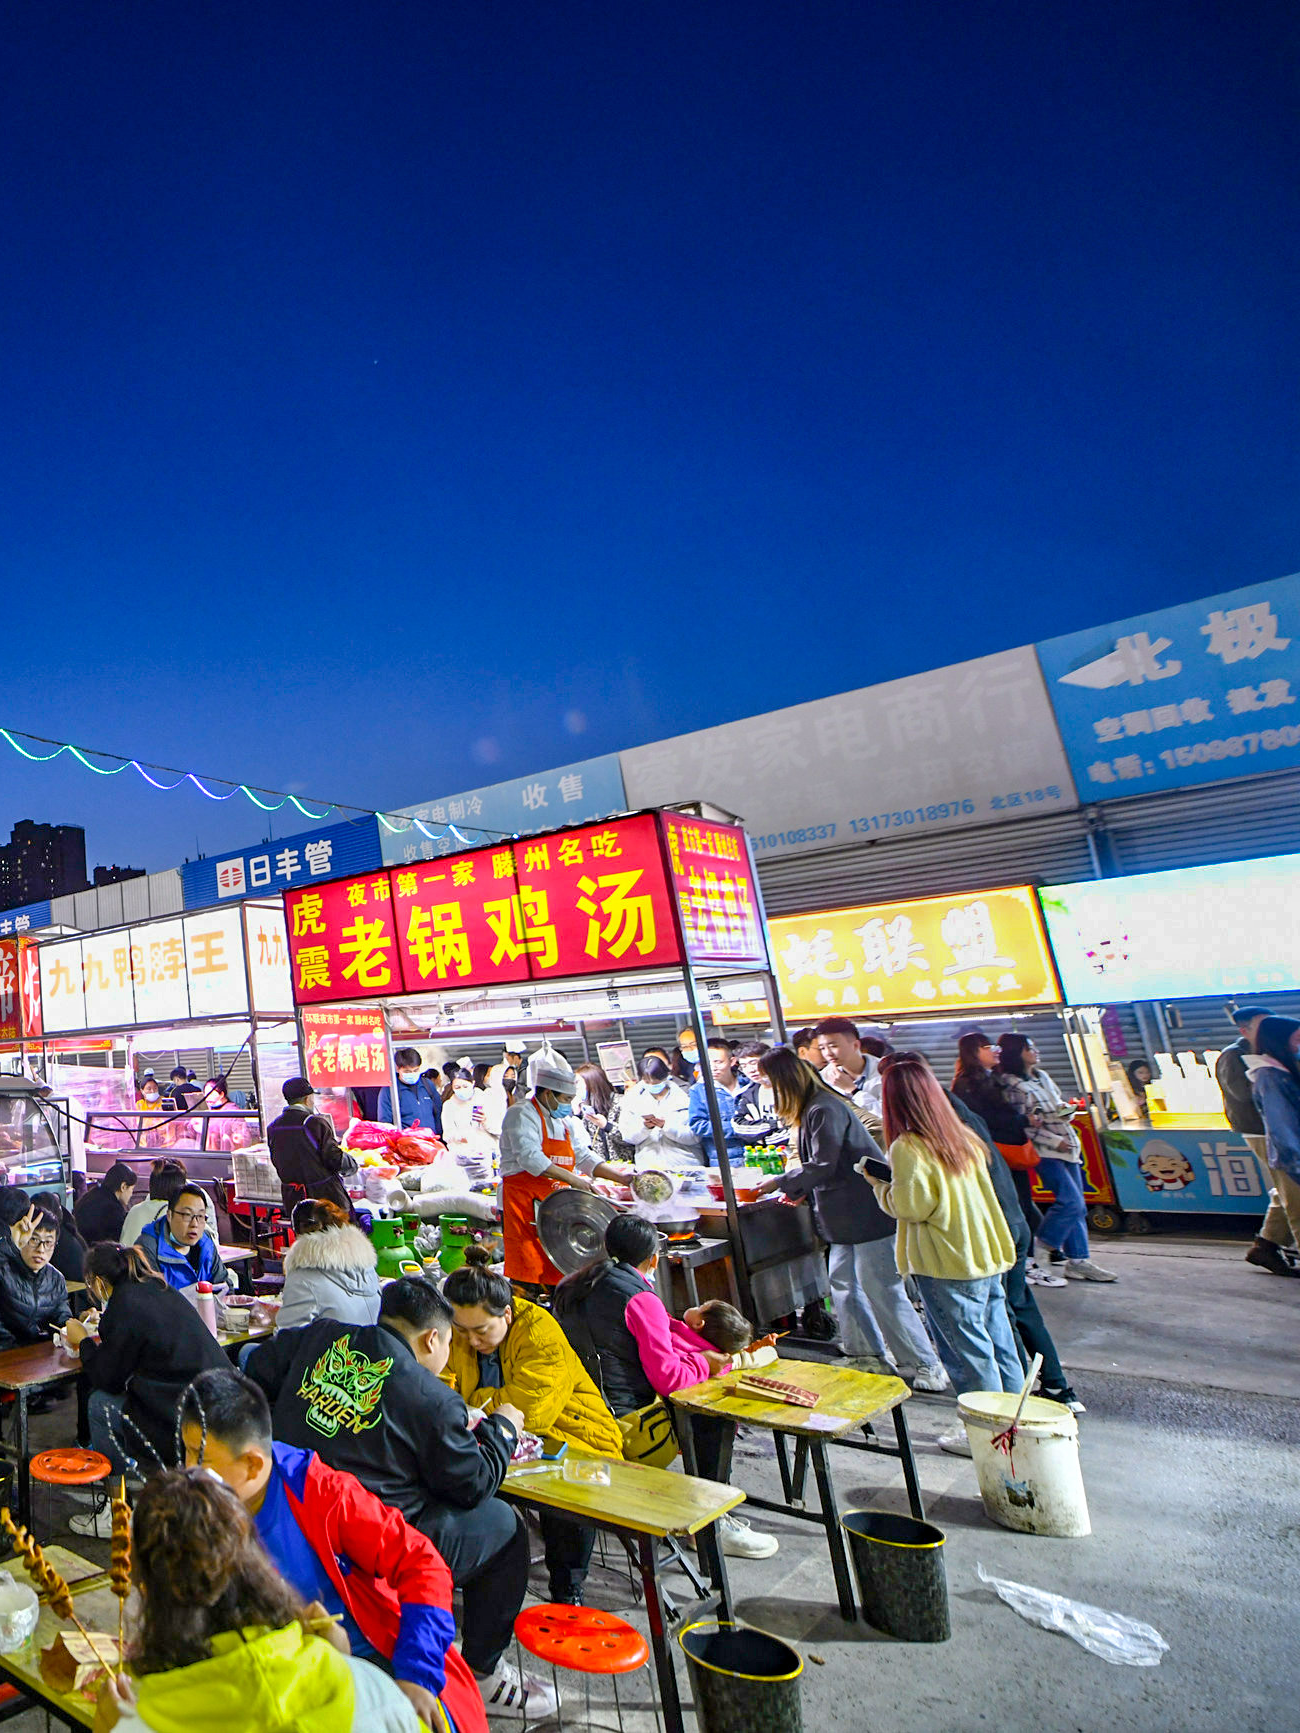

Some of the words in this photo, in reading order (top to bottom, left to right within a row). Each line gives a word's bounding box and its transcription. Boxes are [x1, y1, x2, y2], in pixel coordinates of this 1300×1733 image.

[521, 773, 584, 811] 收售
[849, 799, 975, 834] 13173018976
[249, 840, 333, 887] 日丰管
[346, 860, 476, 908] 夜市第一家
[492, 830, 623, 880] 滕州名吃
[292, 893, 331, 990] 虎震
[339, 868, 657, 988] 老锅鸡汤
[322, 1042, 386, 1073] 老锅鸡汤
[296, 1381, 370, 1434] HARDEN
